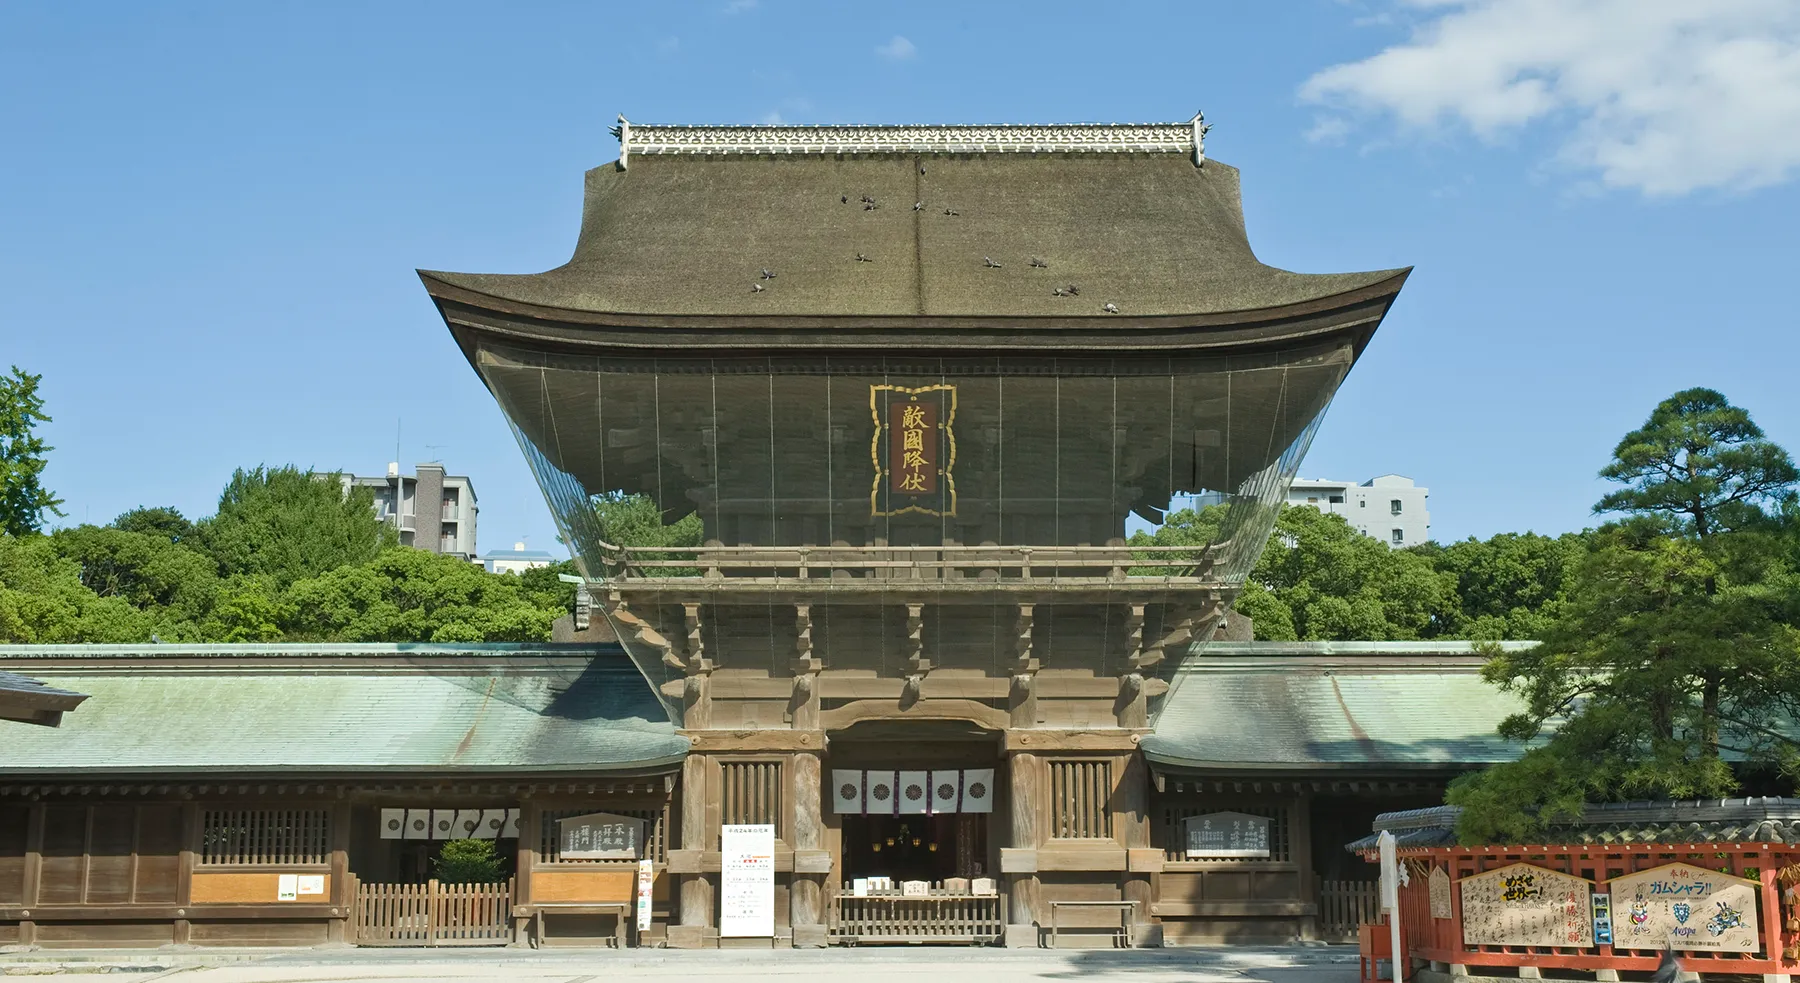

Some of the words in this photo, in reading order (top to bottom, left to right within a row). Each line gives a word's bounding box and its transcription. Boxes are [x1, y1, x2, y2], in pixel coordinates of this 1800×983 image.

[900, 406, 930, 491] 敵國降伏
[1670, 868, 1689, 879] 奉納
[1505, 874, 1534, 887] めざせ
[1650, 881, 1712, 895] ガムシャラ!!
